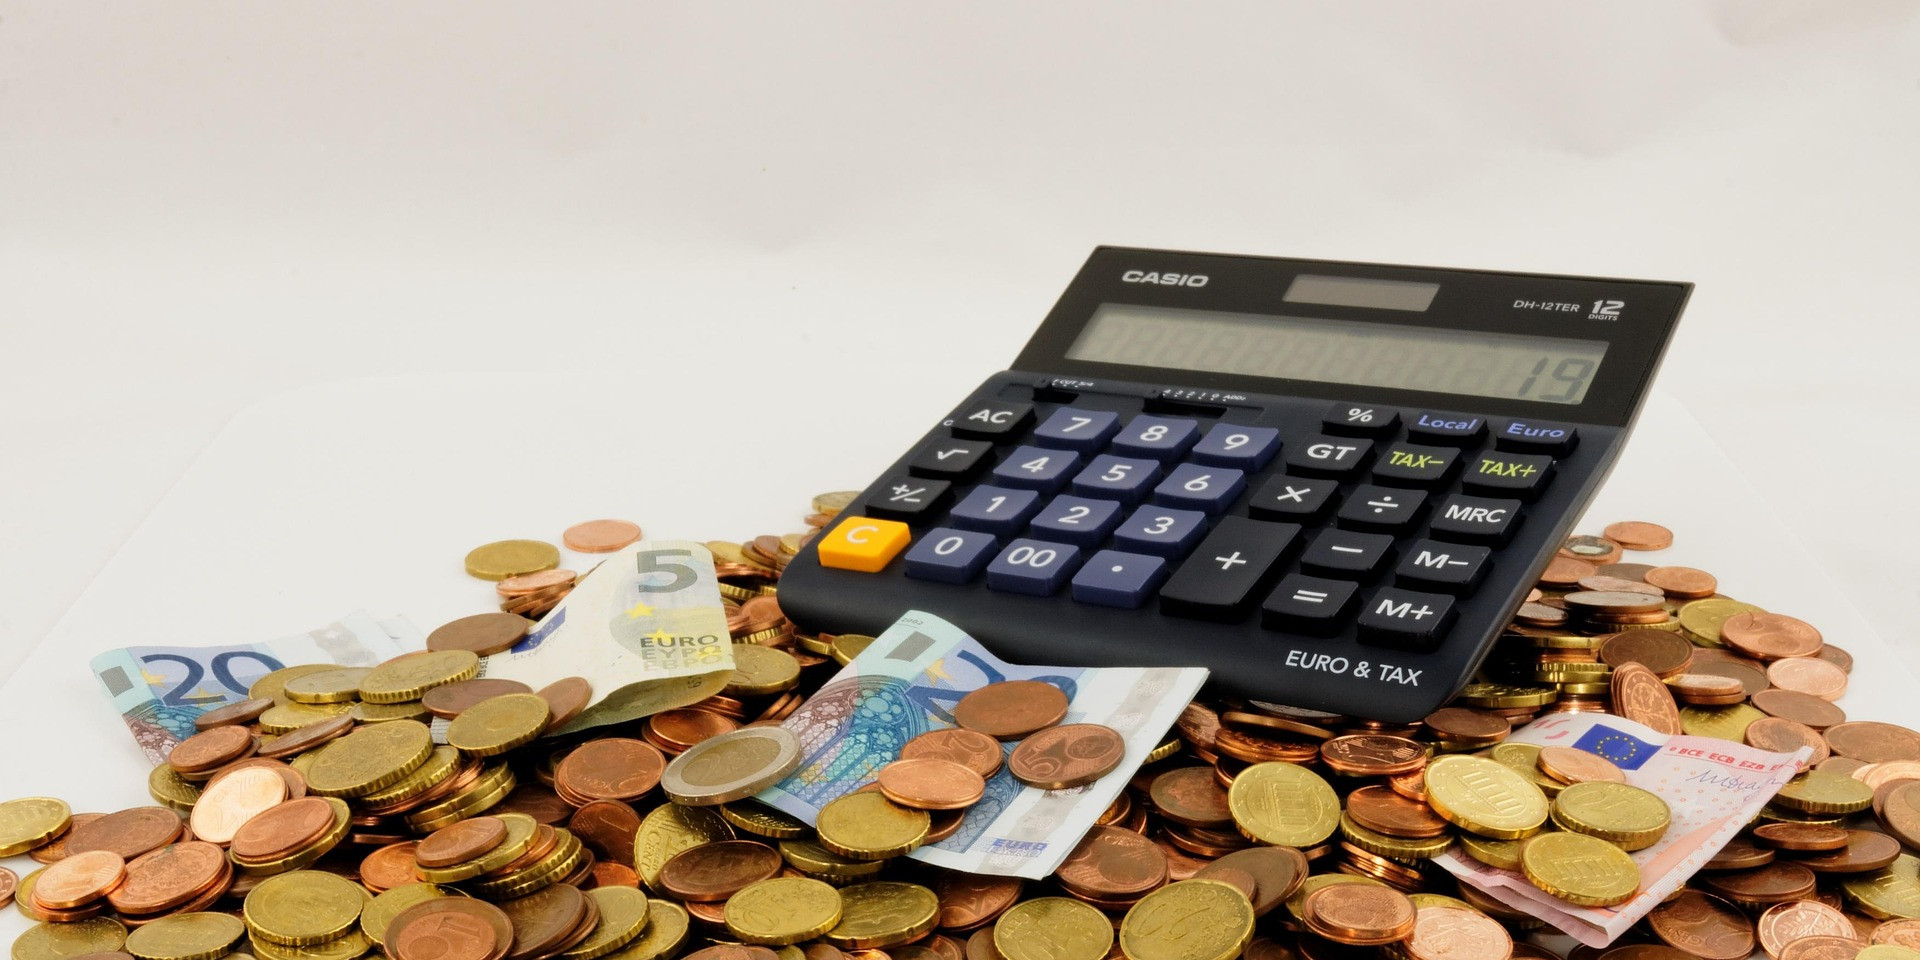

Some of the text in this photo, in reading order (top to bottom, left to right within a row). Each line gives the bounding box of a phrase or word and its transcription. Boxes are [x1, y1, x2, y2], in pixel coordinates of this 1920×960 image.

[1122, 270, 1209, 288] CASIO
[1513, 300, 1580, 312] DH-12TER
[1591, 299, 1625, 316] 12
[968, 409, 1014, 424] AC
[1062, 416, 1092, 432] 7
[1418, 414, 1478, 430] Local
[1140, 425, 1169, 442] 8
[1507, 422, 1566, 438] Euro
[1224, 434, 1250, 450] 9
[1307, 443, 1357, 461] GT
[1021, 457, 1050, 473] 4
[1101, 464, 1132, 482] 5
[1479, 459, 1537, 478] TAX+
[1184, 474, 1211, 492] 6
[986, 496, 1006, 513] 1
[1057, 506, 1090, 524] 2
[1444, 504, 1507, 524] MRC
[846, 525, 879, 544] C
[1143, 516, 1175, 535] 3
[934, 536, 964, 555] 0
[1007, 546, 1056, 568] 00
[636, 548, 698, 593] 5
[1375, 599, 1434, 620] M+
[901, 617, 925, 626] 2002
[640, 634, 719, 648] EURO
[1285, 649, 1423, 687] EURO & TAX
[1017, 748, 1062, 778] 5
[1678, 747, 1704, 758] BCE
[1708, 753, 1736, 764] ECB
[1738, 760, 1766, 771] EZB
[992, 837, 1049, 851] EURO
